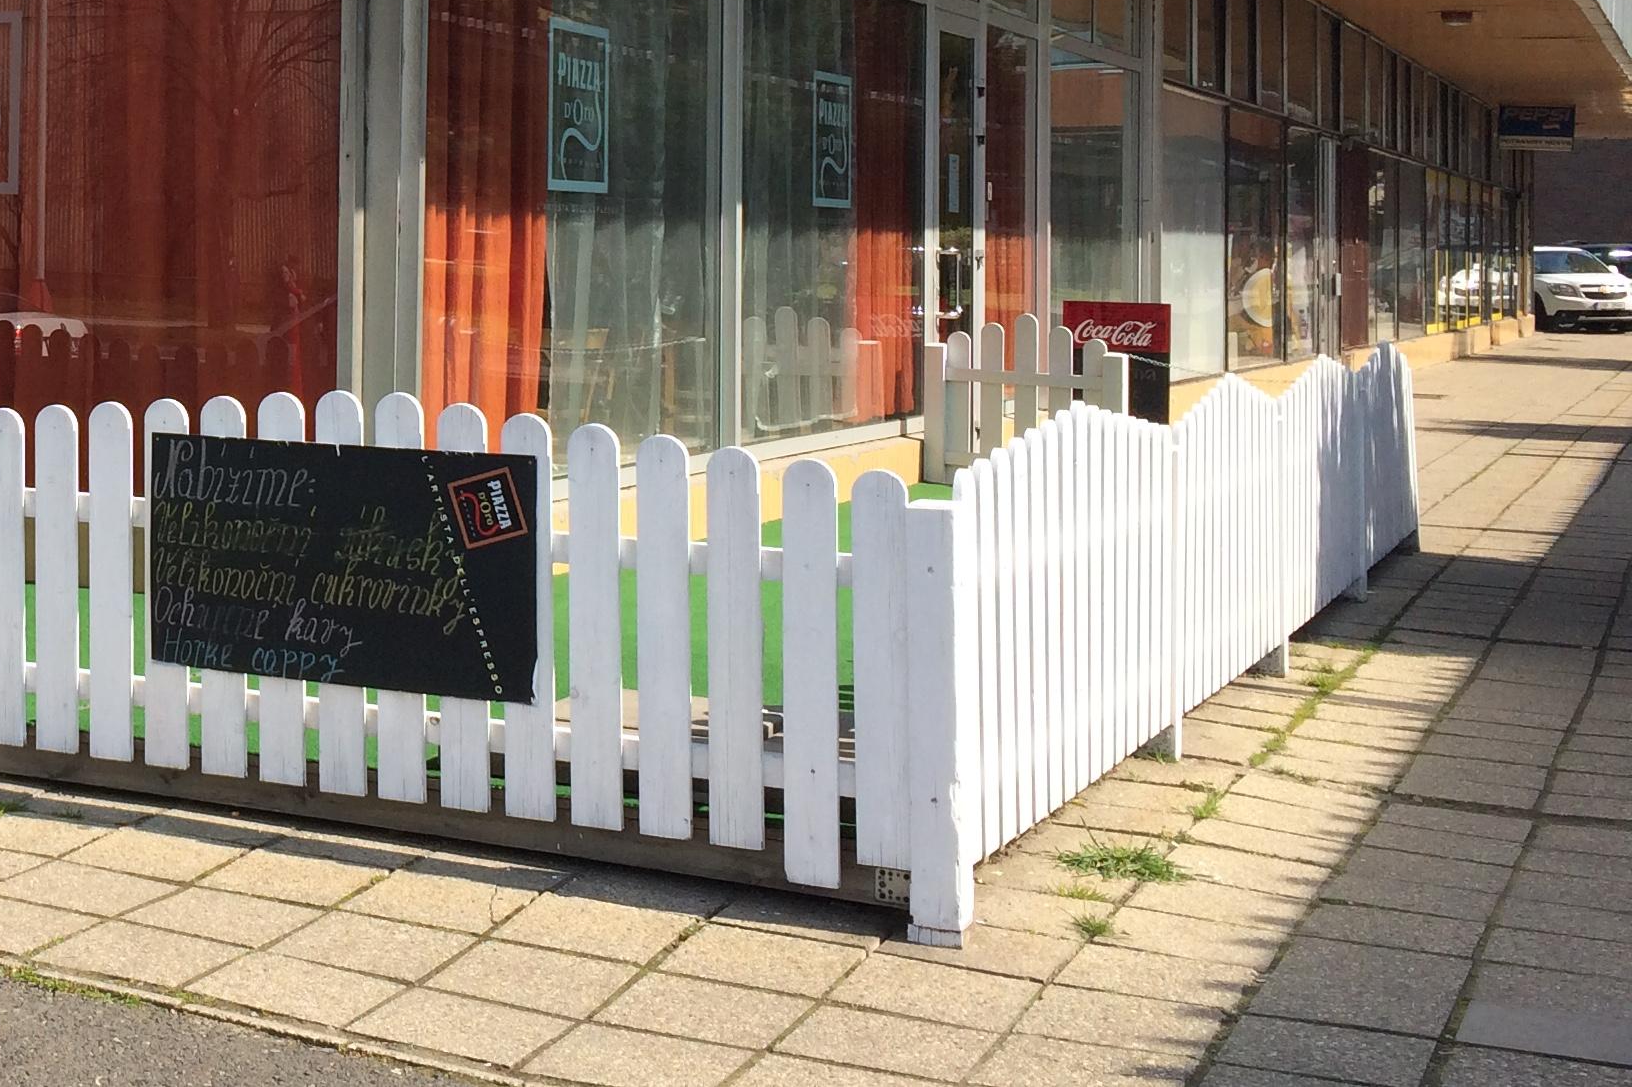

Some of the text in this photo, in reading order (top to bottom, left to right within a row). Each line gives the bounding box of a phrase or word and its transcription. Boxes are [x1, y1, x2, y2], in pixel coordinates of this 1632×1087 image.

[558, 52, 601, 93] PIAZZA
[1073, 319, 1157, 348] Coca-Cola
[421, 455, 454, 545] L'ARTISTA
[486, 479, 512, 530] PIAZZA
